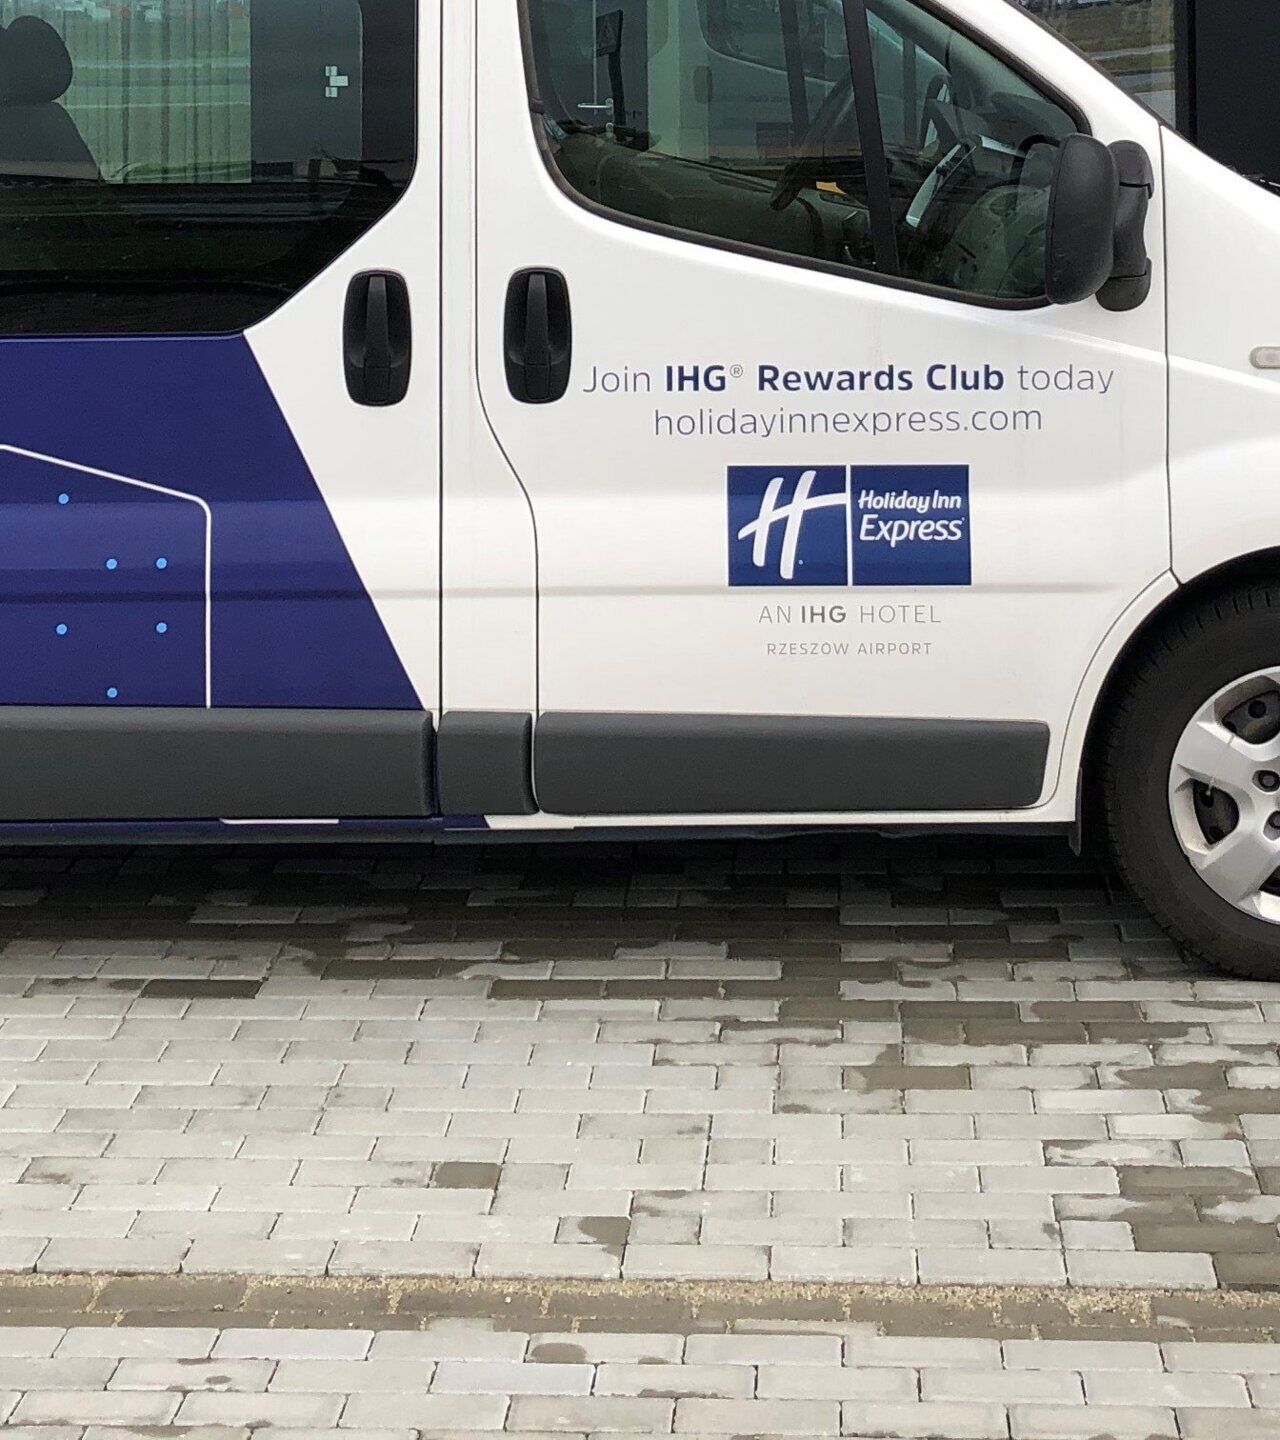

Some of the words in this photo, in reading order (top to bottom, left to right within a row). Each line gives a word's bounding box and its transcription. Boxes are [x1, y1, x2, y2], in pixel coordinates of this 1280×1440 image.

[583, 365, 651, 393] Join
[758, 363, 914, 392] Rewards
[926, 363, 1005, 392] Club
[1017, 363, 1115, 394] today
[654, 407, 1043, 438] holidayinnexpress.com
[858, 489, 931, 514] Holiday
[932, 489, 962, 510] Inn
[859, 513, 964, 548] Express
[758, 605, 792, 623] AN
[801, 605, 847, 624] IHG
[860, 604, 941, 623] HOTEL
[857, 642, 932, 656] AIRPORT
